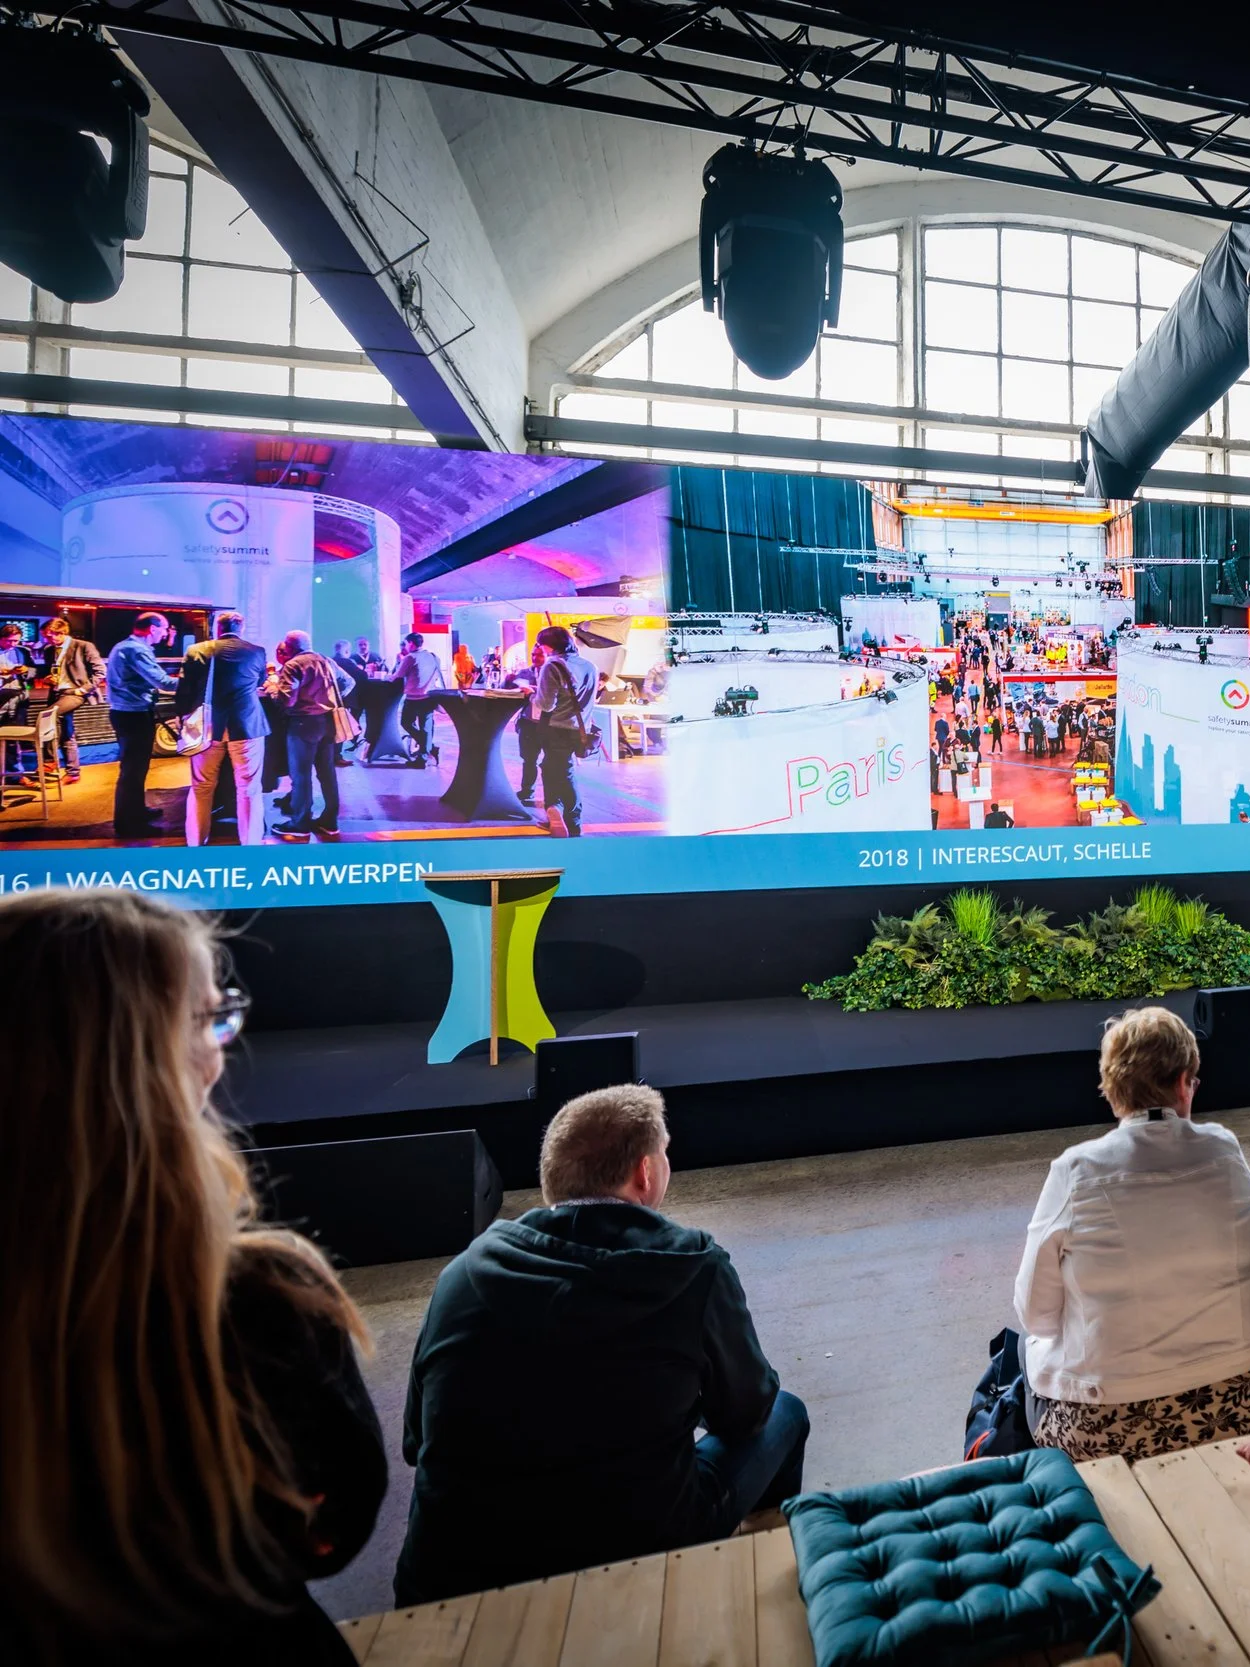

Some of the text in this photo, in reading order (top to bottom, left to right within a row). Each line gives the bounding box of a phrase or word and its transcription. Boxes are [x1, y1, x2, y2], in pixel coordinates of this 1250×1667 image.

[786, 737, 904, 817] Paris
[858, 849, 909, 868] 2018
[932, 844, 1067, 865] INTERESCAUT,
[1073, 842, 1152, 861] SCHELLE
[65, 867, 254, 891] WAAGNATIE,
[261, 862, 433, 887] ANTWERPEN
